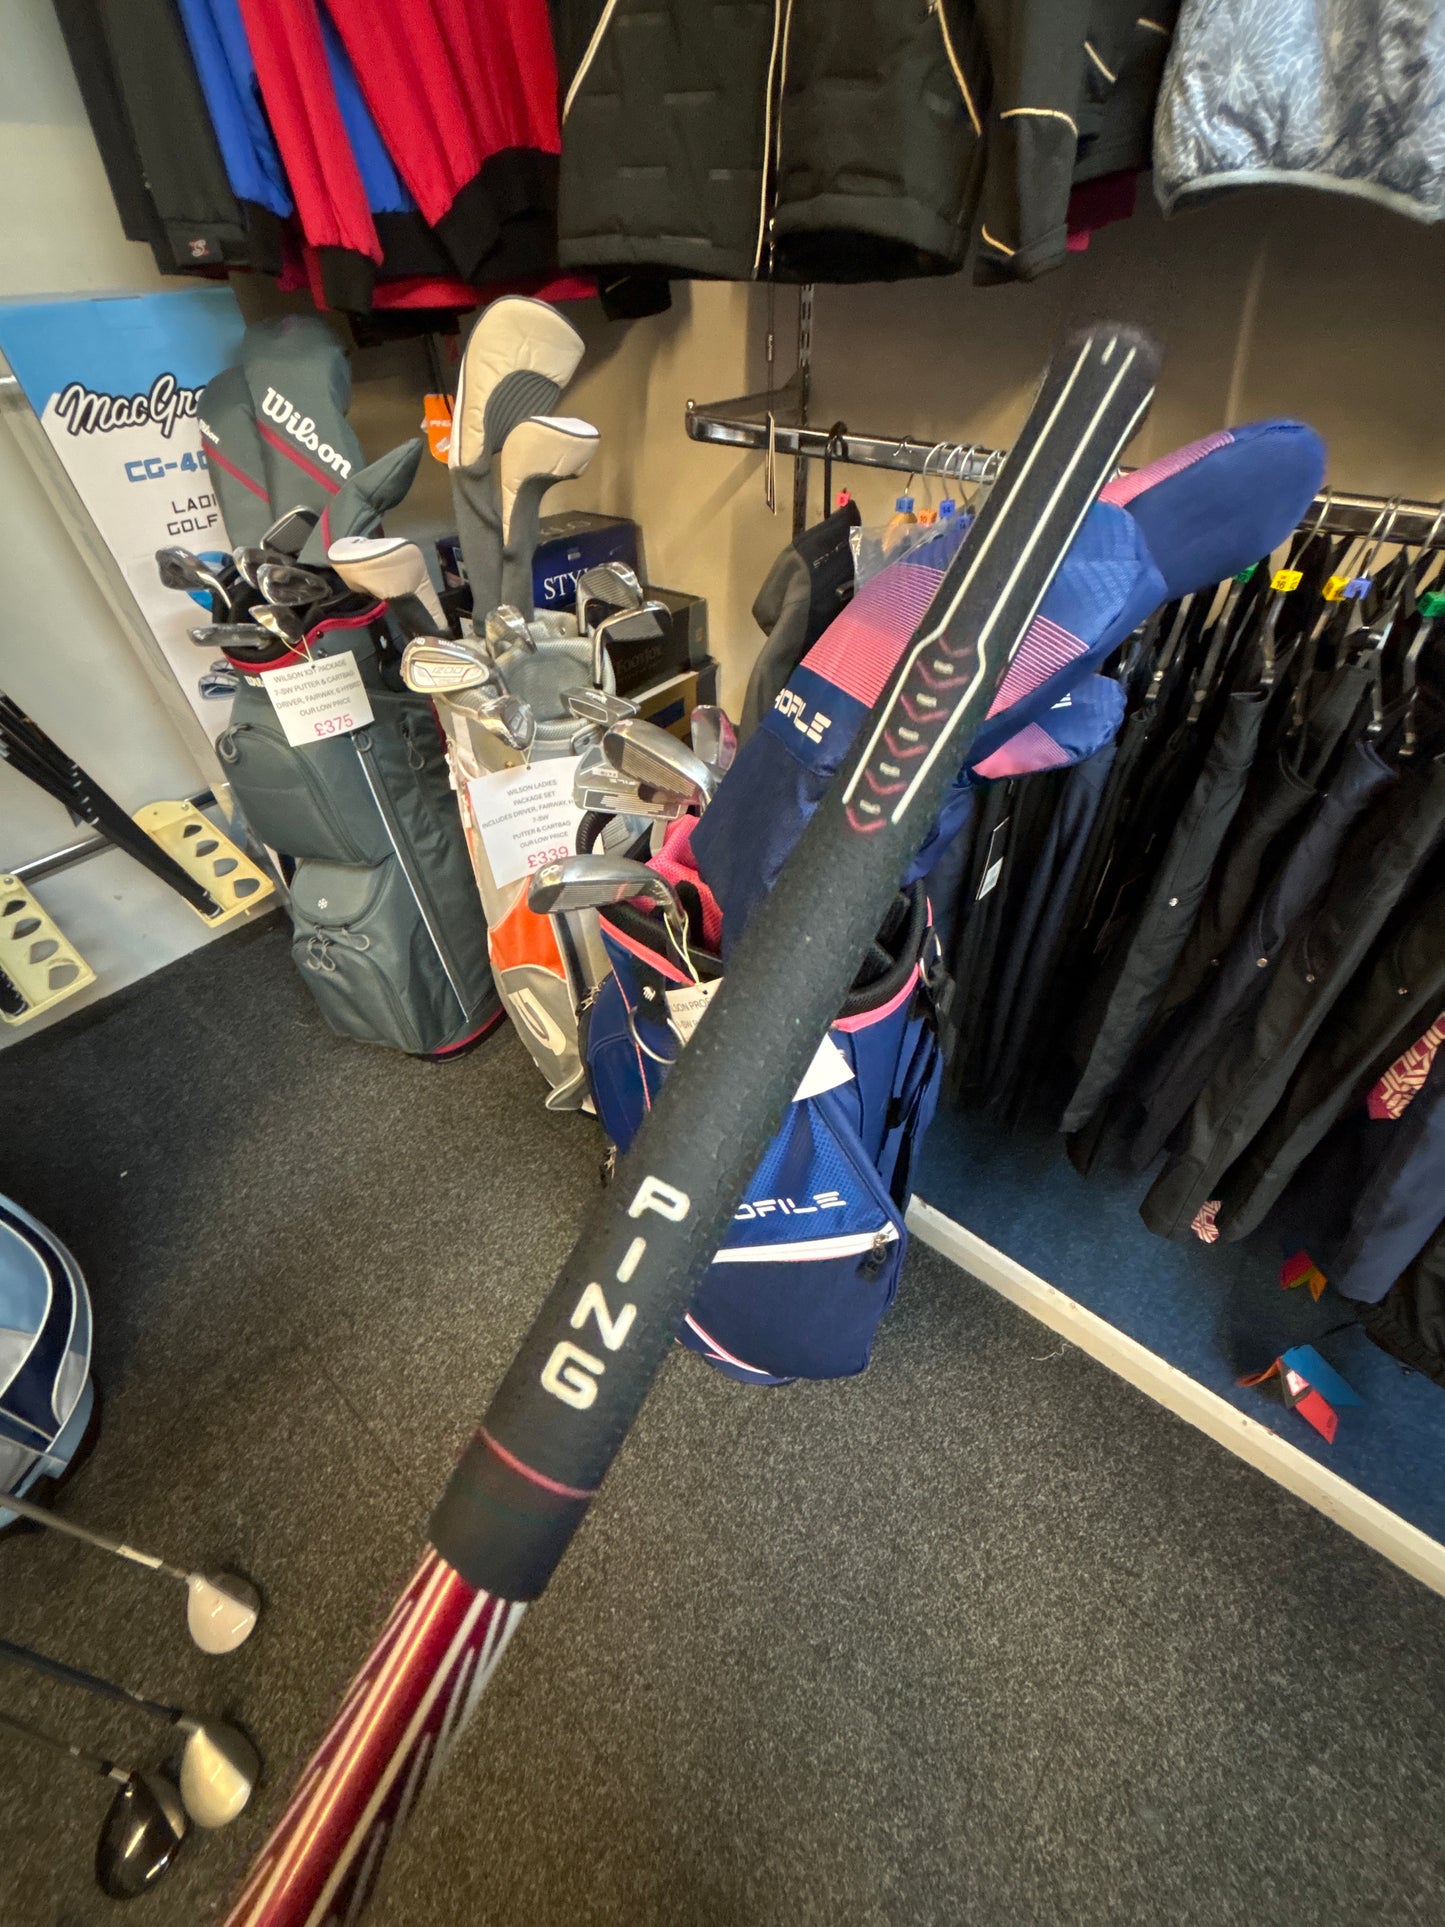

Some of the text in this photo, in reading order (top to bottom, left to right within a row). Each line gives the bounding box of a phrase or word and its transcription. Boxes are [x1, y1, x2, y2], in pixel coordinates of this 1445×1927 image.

[262, 386, 352, 480] Wilson
[171, 493, 217, 514] LADI
[166, 513, 218, 536] GOLF
[543, 567, 590, 600] STY
[273, 670, 304, 684] WILSON
[317, 659, 347, 672] PACKAGE
[294, 679, 320, 692] PUTTER
[299, 697, 351, 717] OUR LOW PRICE
[314, 713, 354, 737] £375
[506, 779, 558, 796] WILSON LADIES
[512, 790, 556, 806] PACKAGE SET
[512, 827, 537, 840] PUTTER
[519, 840, 534, 849] OUR
[534, 835, 549, 845] LOW
[527, 845, 569, 869] £339
[541, 1175, 690, 1410] PING
